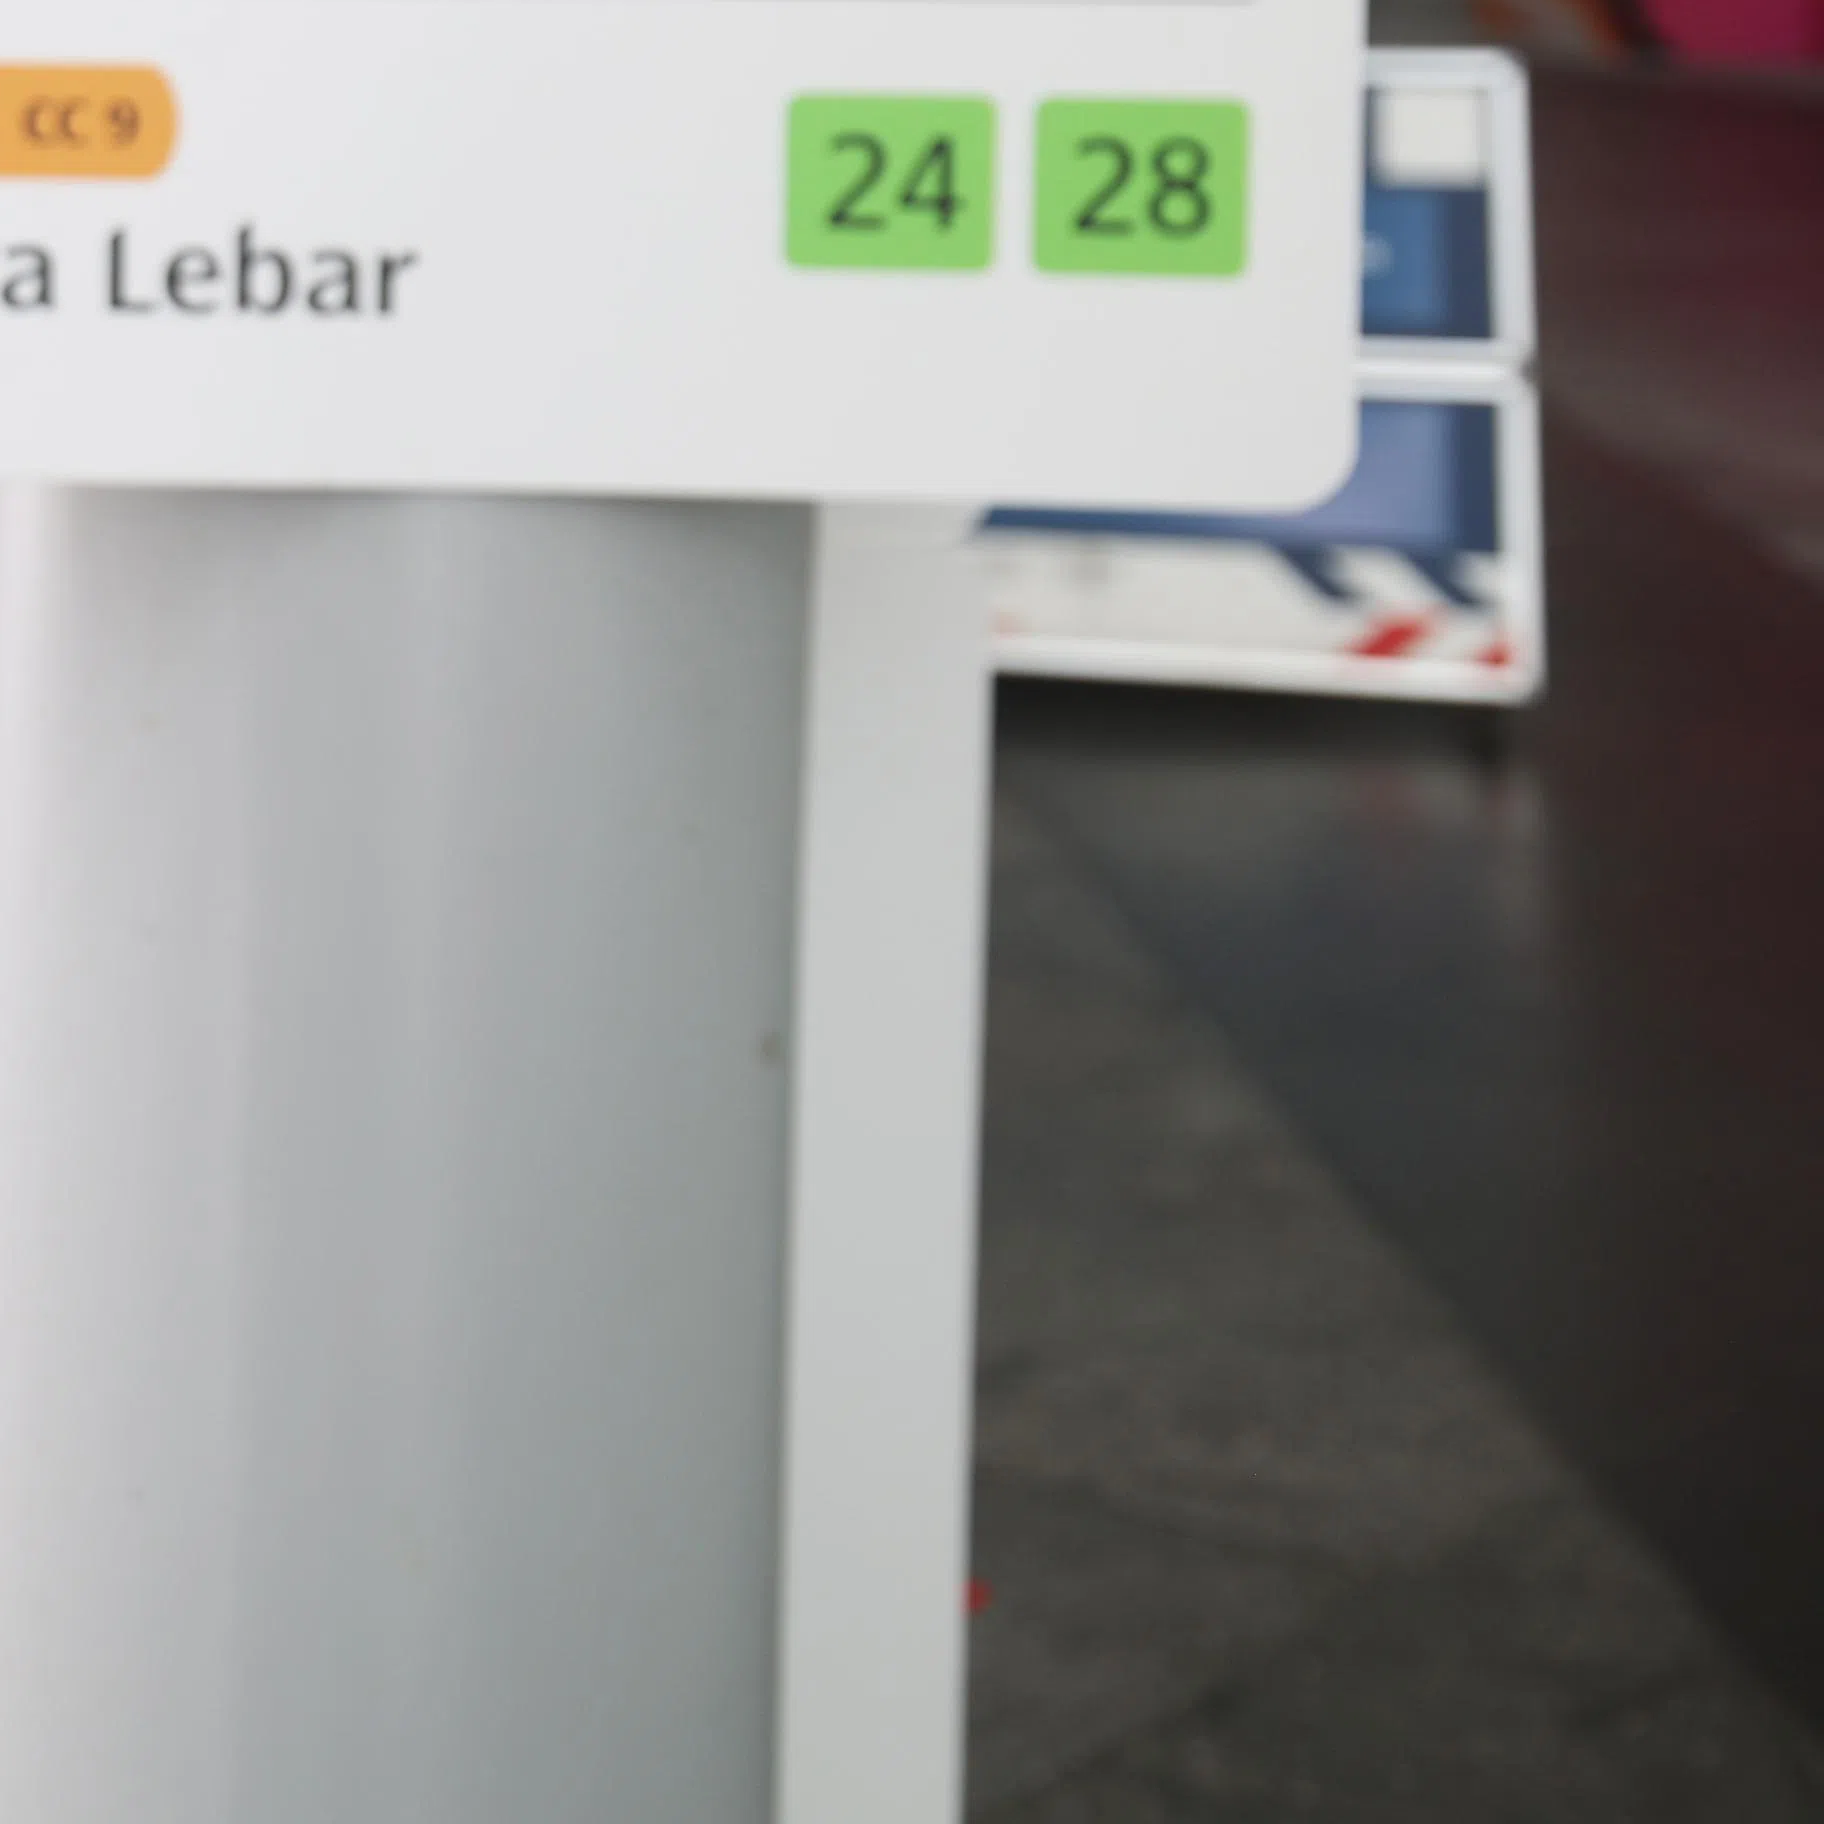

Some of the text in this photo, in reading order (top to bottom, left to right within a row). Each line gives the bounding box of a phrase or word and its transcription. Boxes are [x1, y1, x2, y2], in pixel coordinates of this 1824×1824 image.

[16, 93, 143, 151] CC 9
[822, 131, 966, 234] 24
[1069, 133, 1215, 242] 28
[106, 224, 418, 318] Lebar
